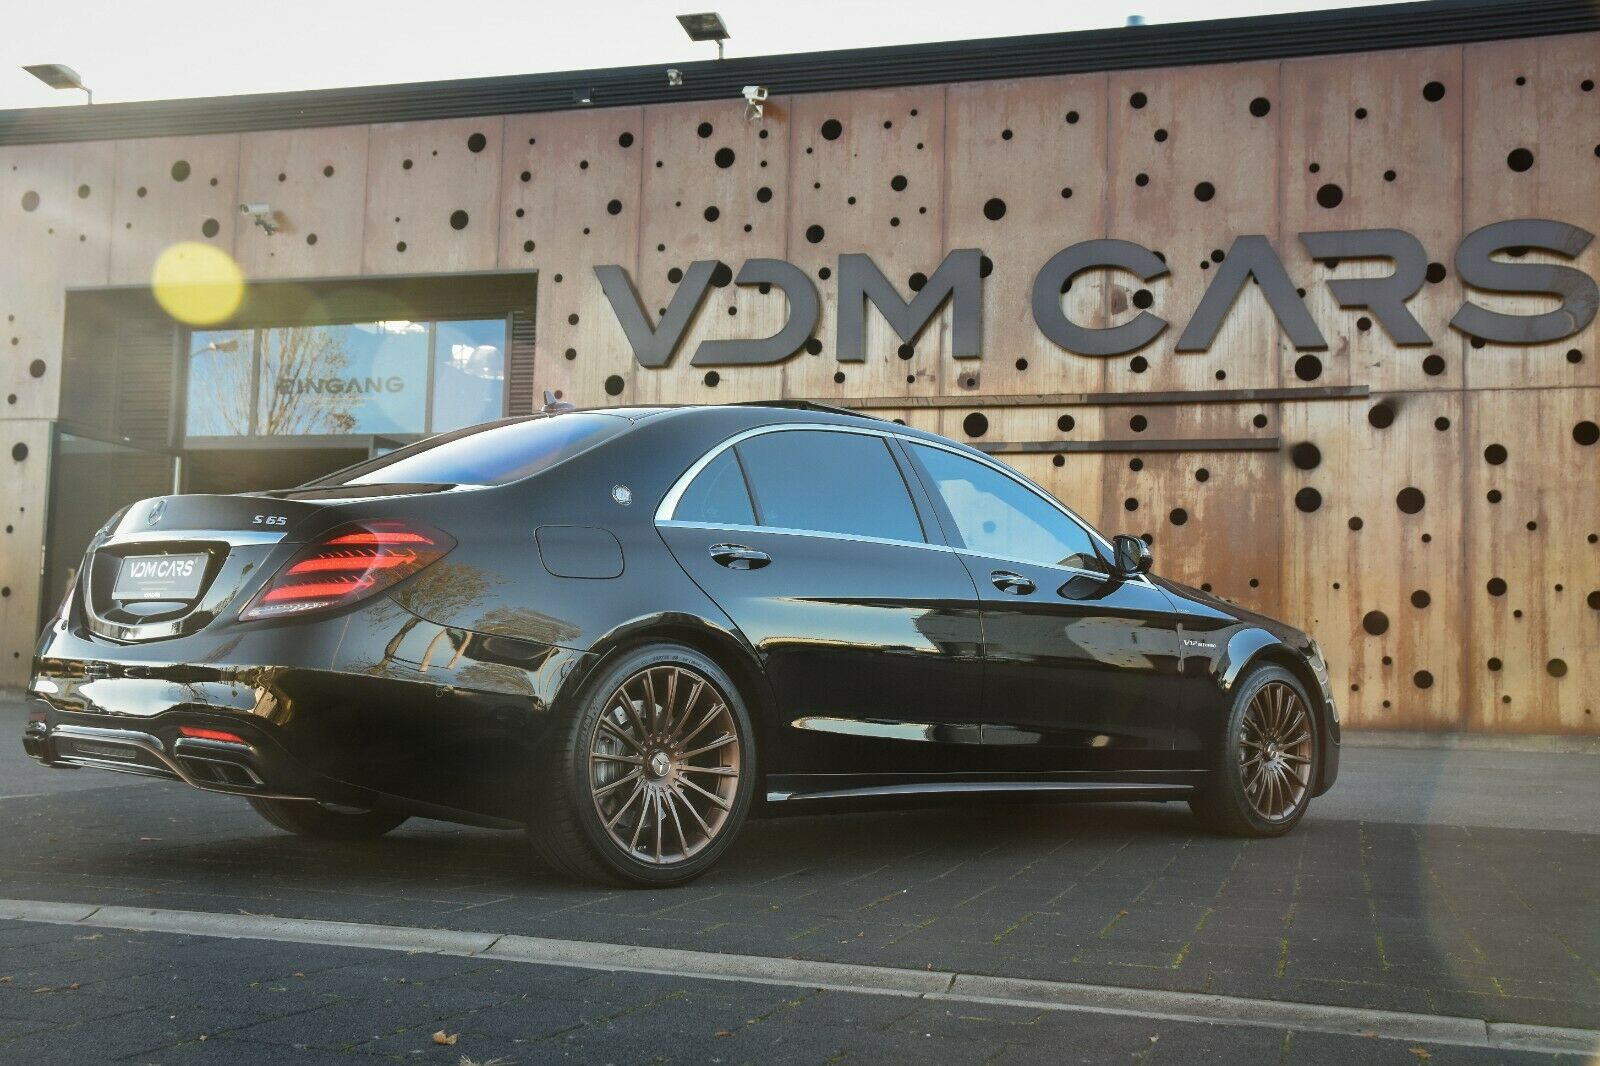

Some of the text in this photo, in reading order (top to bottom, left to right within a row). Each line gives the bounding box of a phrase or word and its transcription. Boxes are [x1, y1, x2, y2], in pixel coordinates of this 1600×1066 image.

[593, 218, 1600, 369] VDM CARS
[252, 515, 288, 526] S 65
[130, 559, 195, 578] VDM CARS
